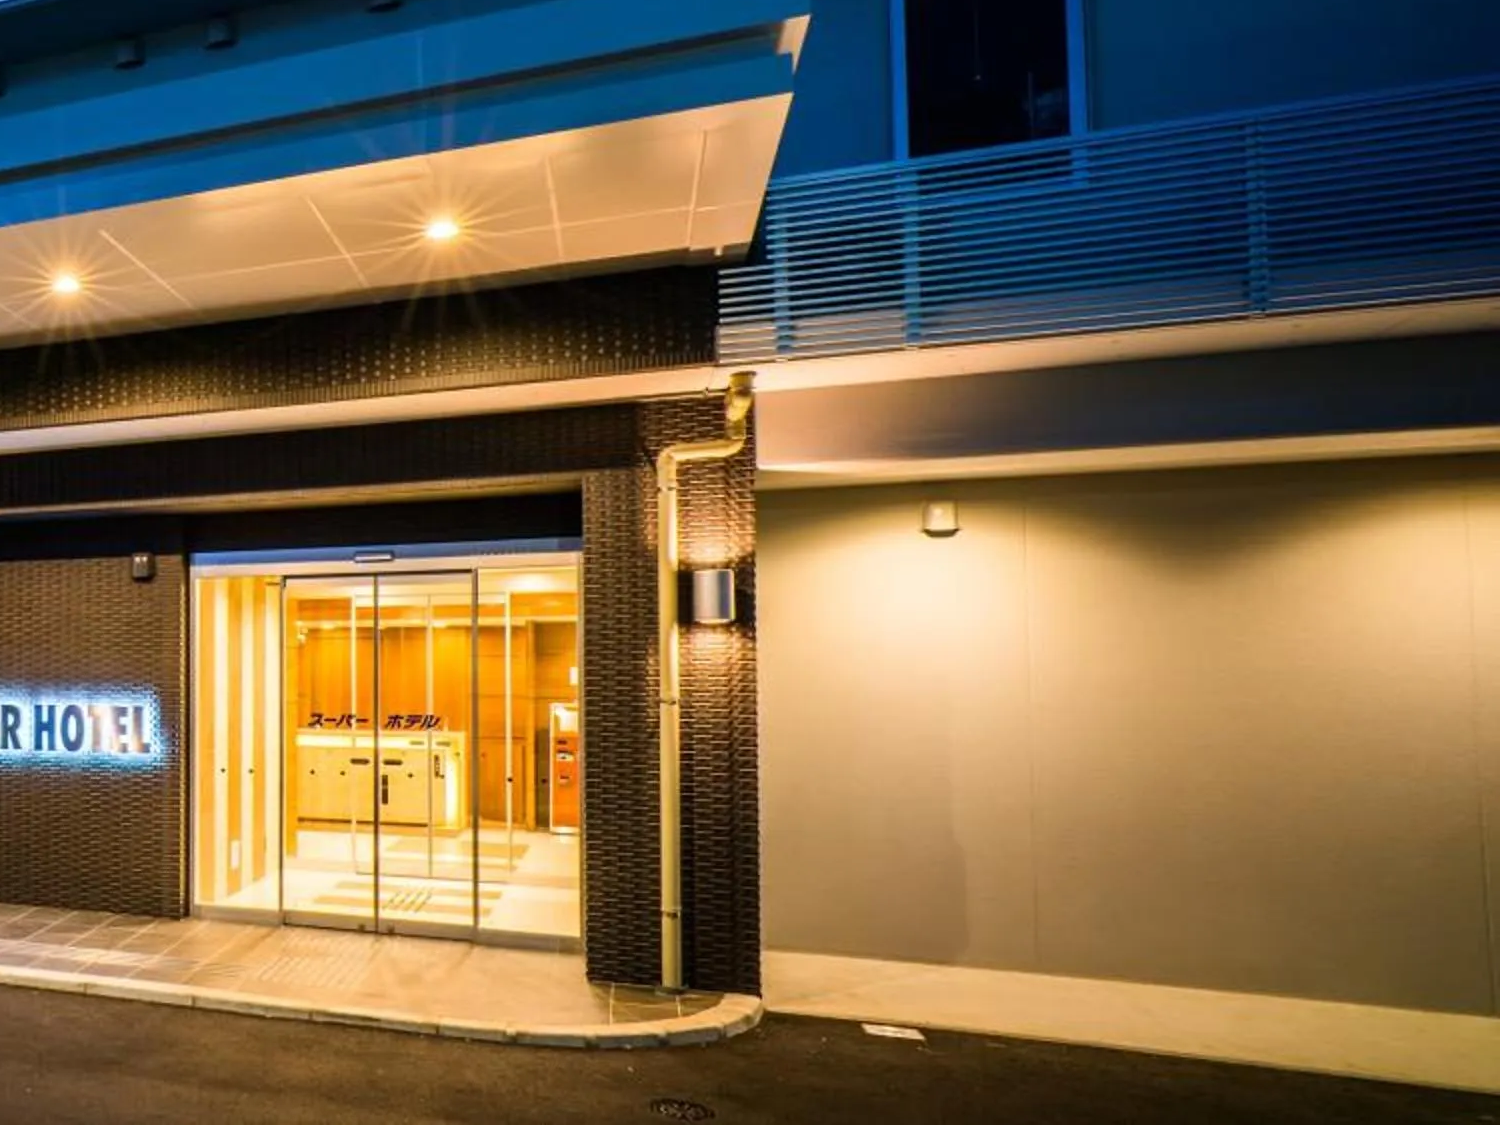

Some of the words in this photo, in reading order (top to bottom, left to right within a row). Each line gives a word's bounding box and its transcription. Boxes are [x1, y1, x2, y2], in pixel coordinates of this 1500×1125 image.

[33, 703, 152, 754] HOTEL
[385, 713, 441, 729] ホテル
